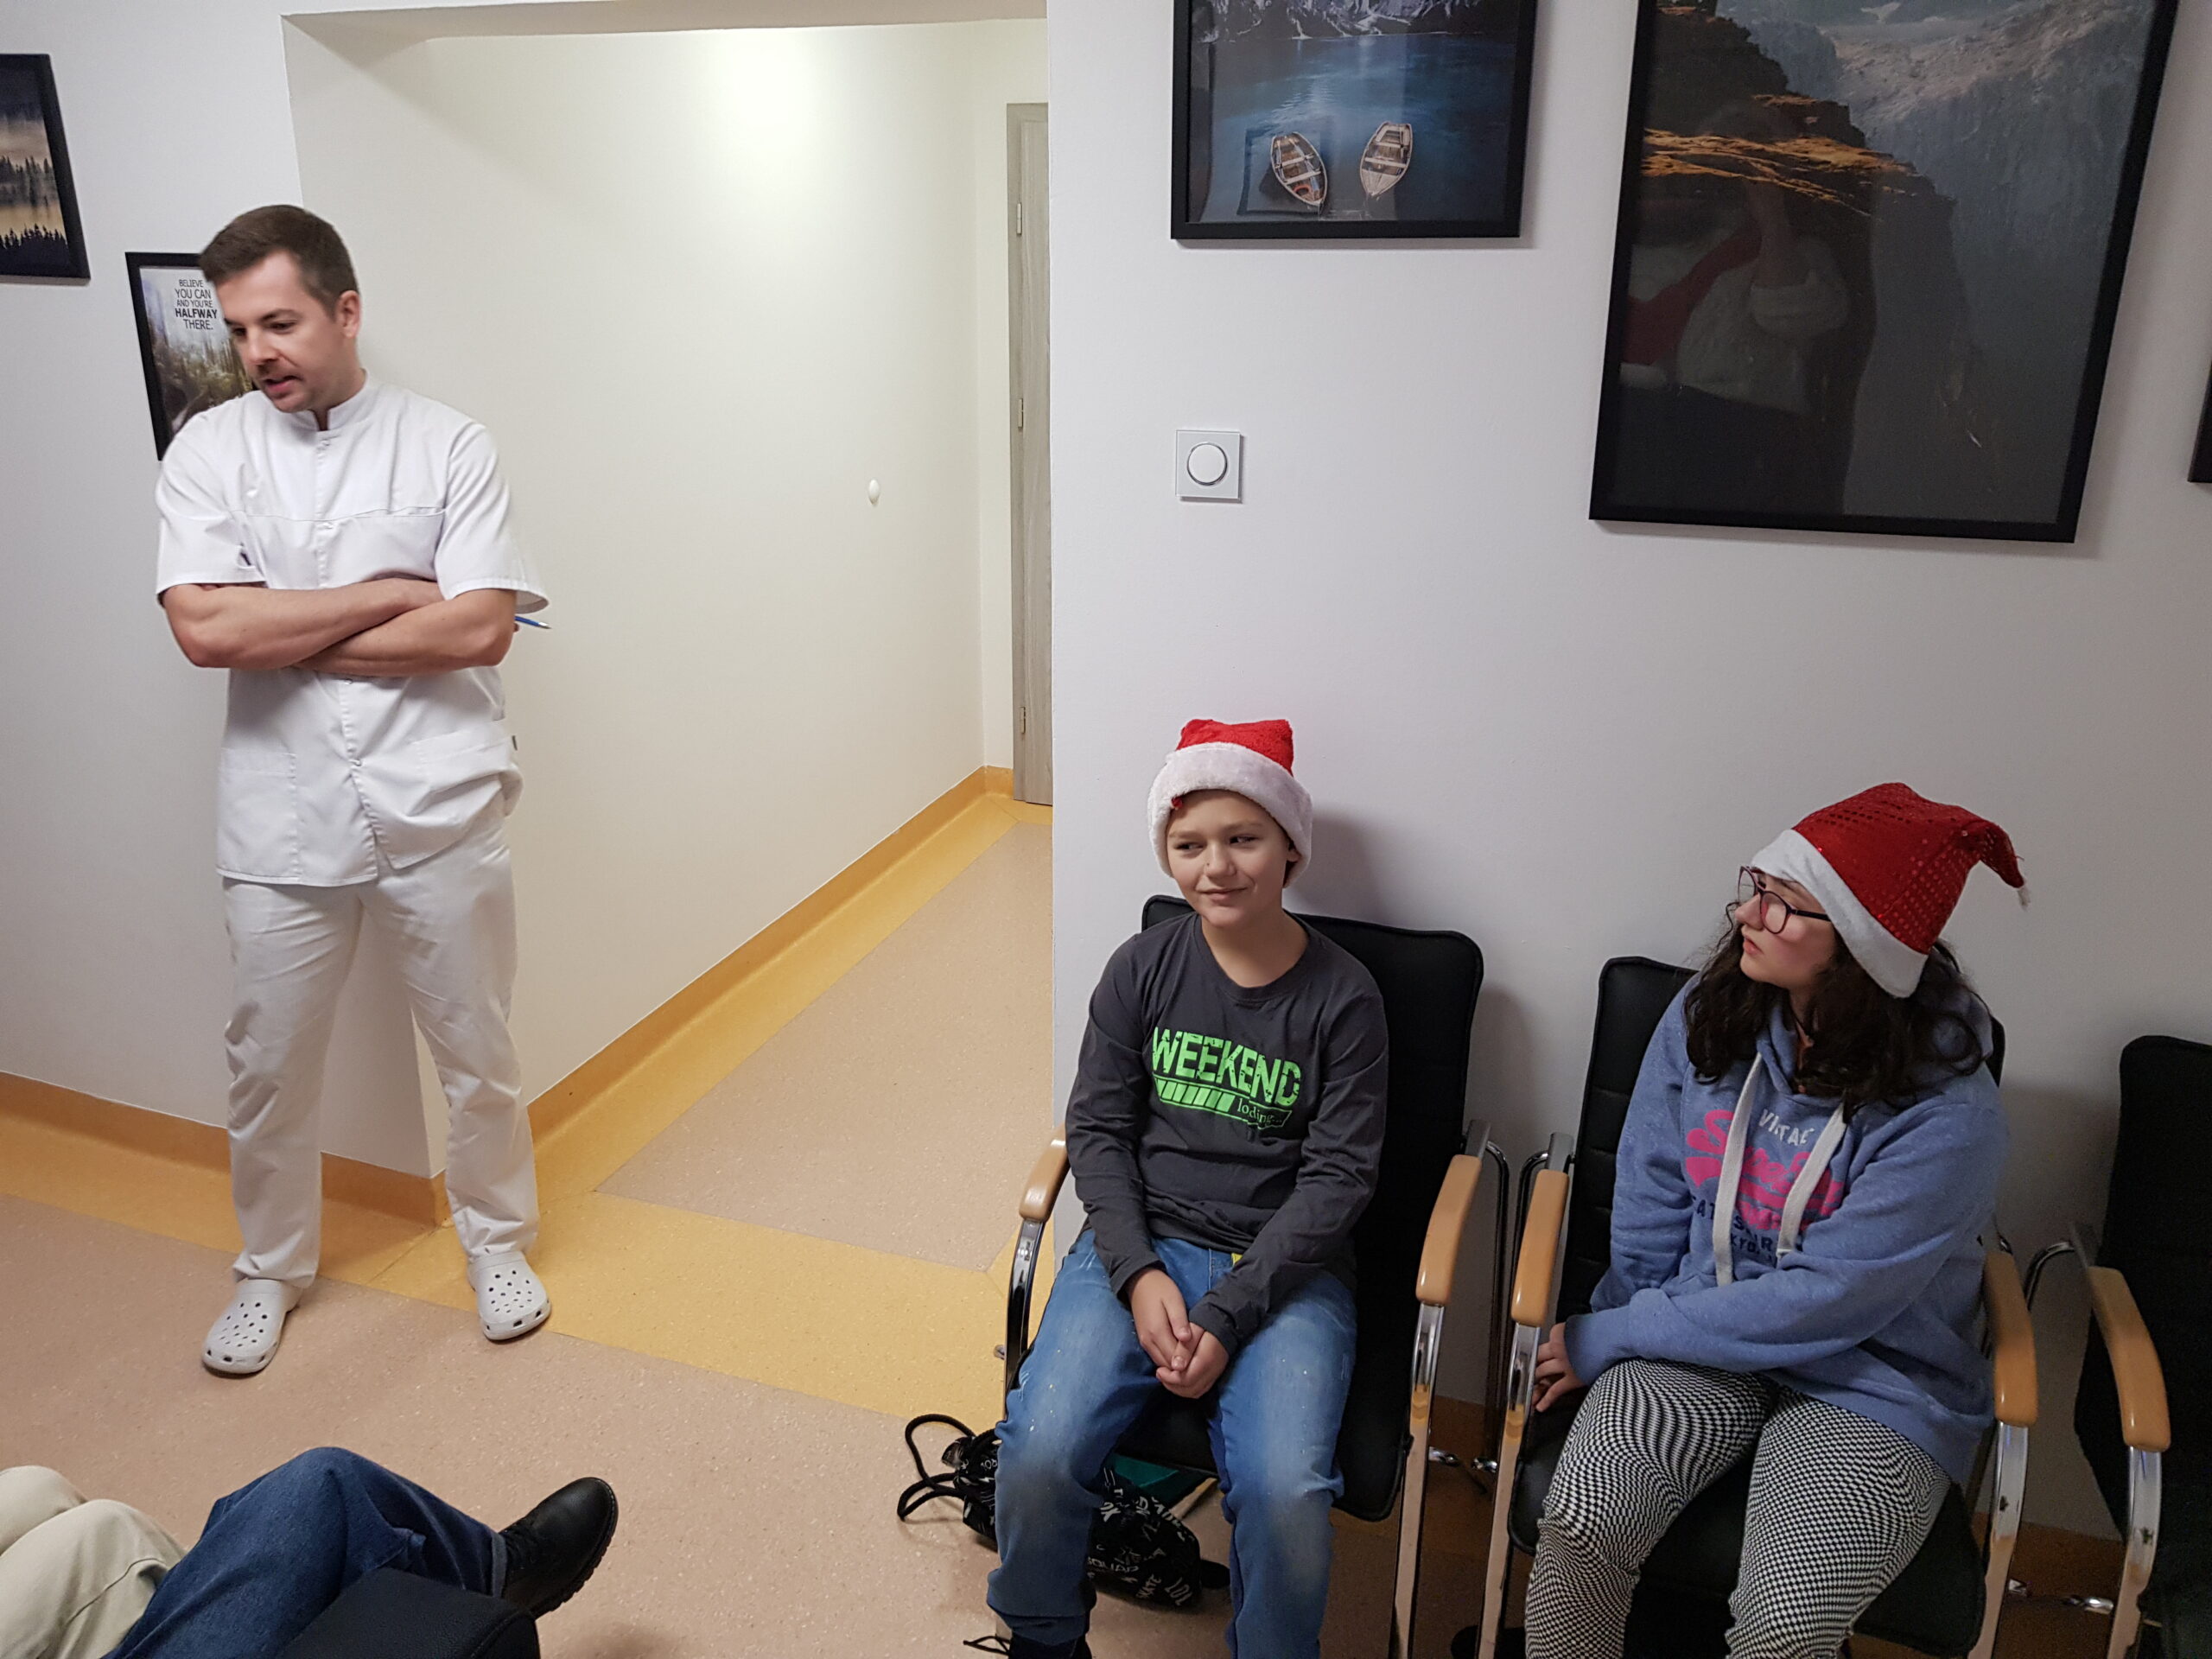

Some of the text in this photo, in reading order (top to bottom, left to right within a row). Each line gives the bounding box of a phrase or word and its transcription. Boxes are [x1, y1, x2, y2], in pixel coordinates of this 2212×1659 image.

[175, 289, 212, 300] YOU CAN
[175, 308, 218, 319] HALFWAY
[183, 319, 213, 330] THERE.
[1152, 1027, 1301, 1107] WEEKEND
